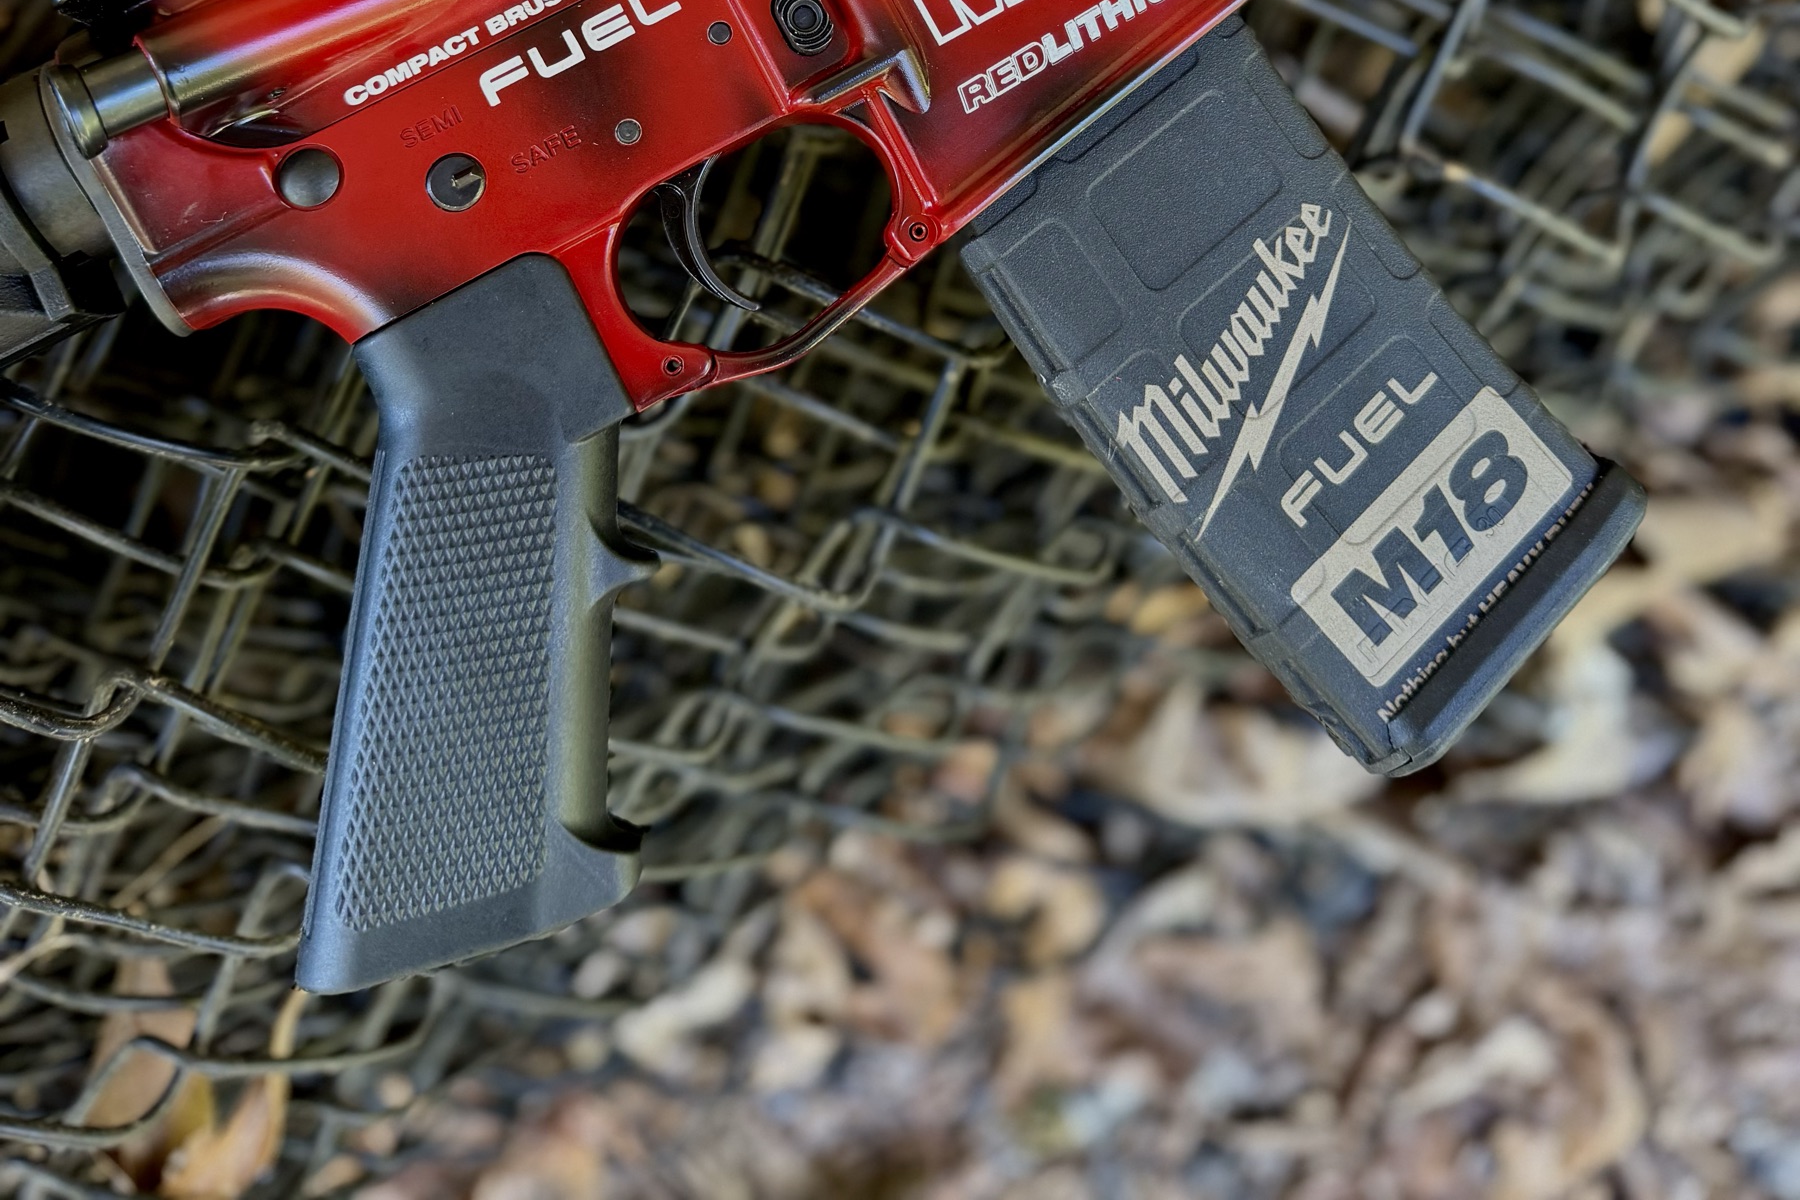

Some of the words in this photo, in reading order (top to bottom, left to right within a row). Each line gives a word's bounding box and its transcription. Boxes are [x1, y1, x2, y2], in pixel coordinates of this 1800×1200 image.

[343, 26, 480, 106] COMPACT
[400, 105, 463, 149] SEMI
[510, 124, 582, 174] SAFE
[1117, 202, 1332, 504] Milwaukee
[1280, 371, 1438, 528] FUEL
[1330, 428, 1529, 648] M18
